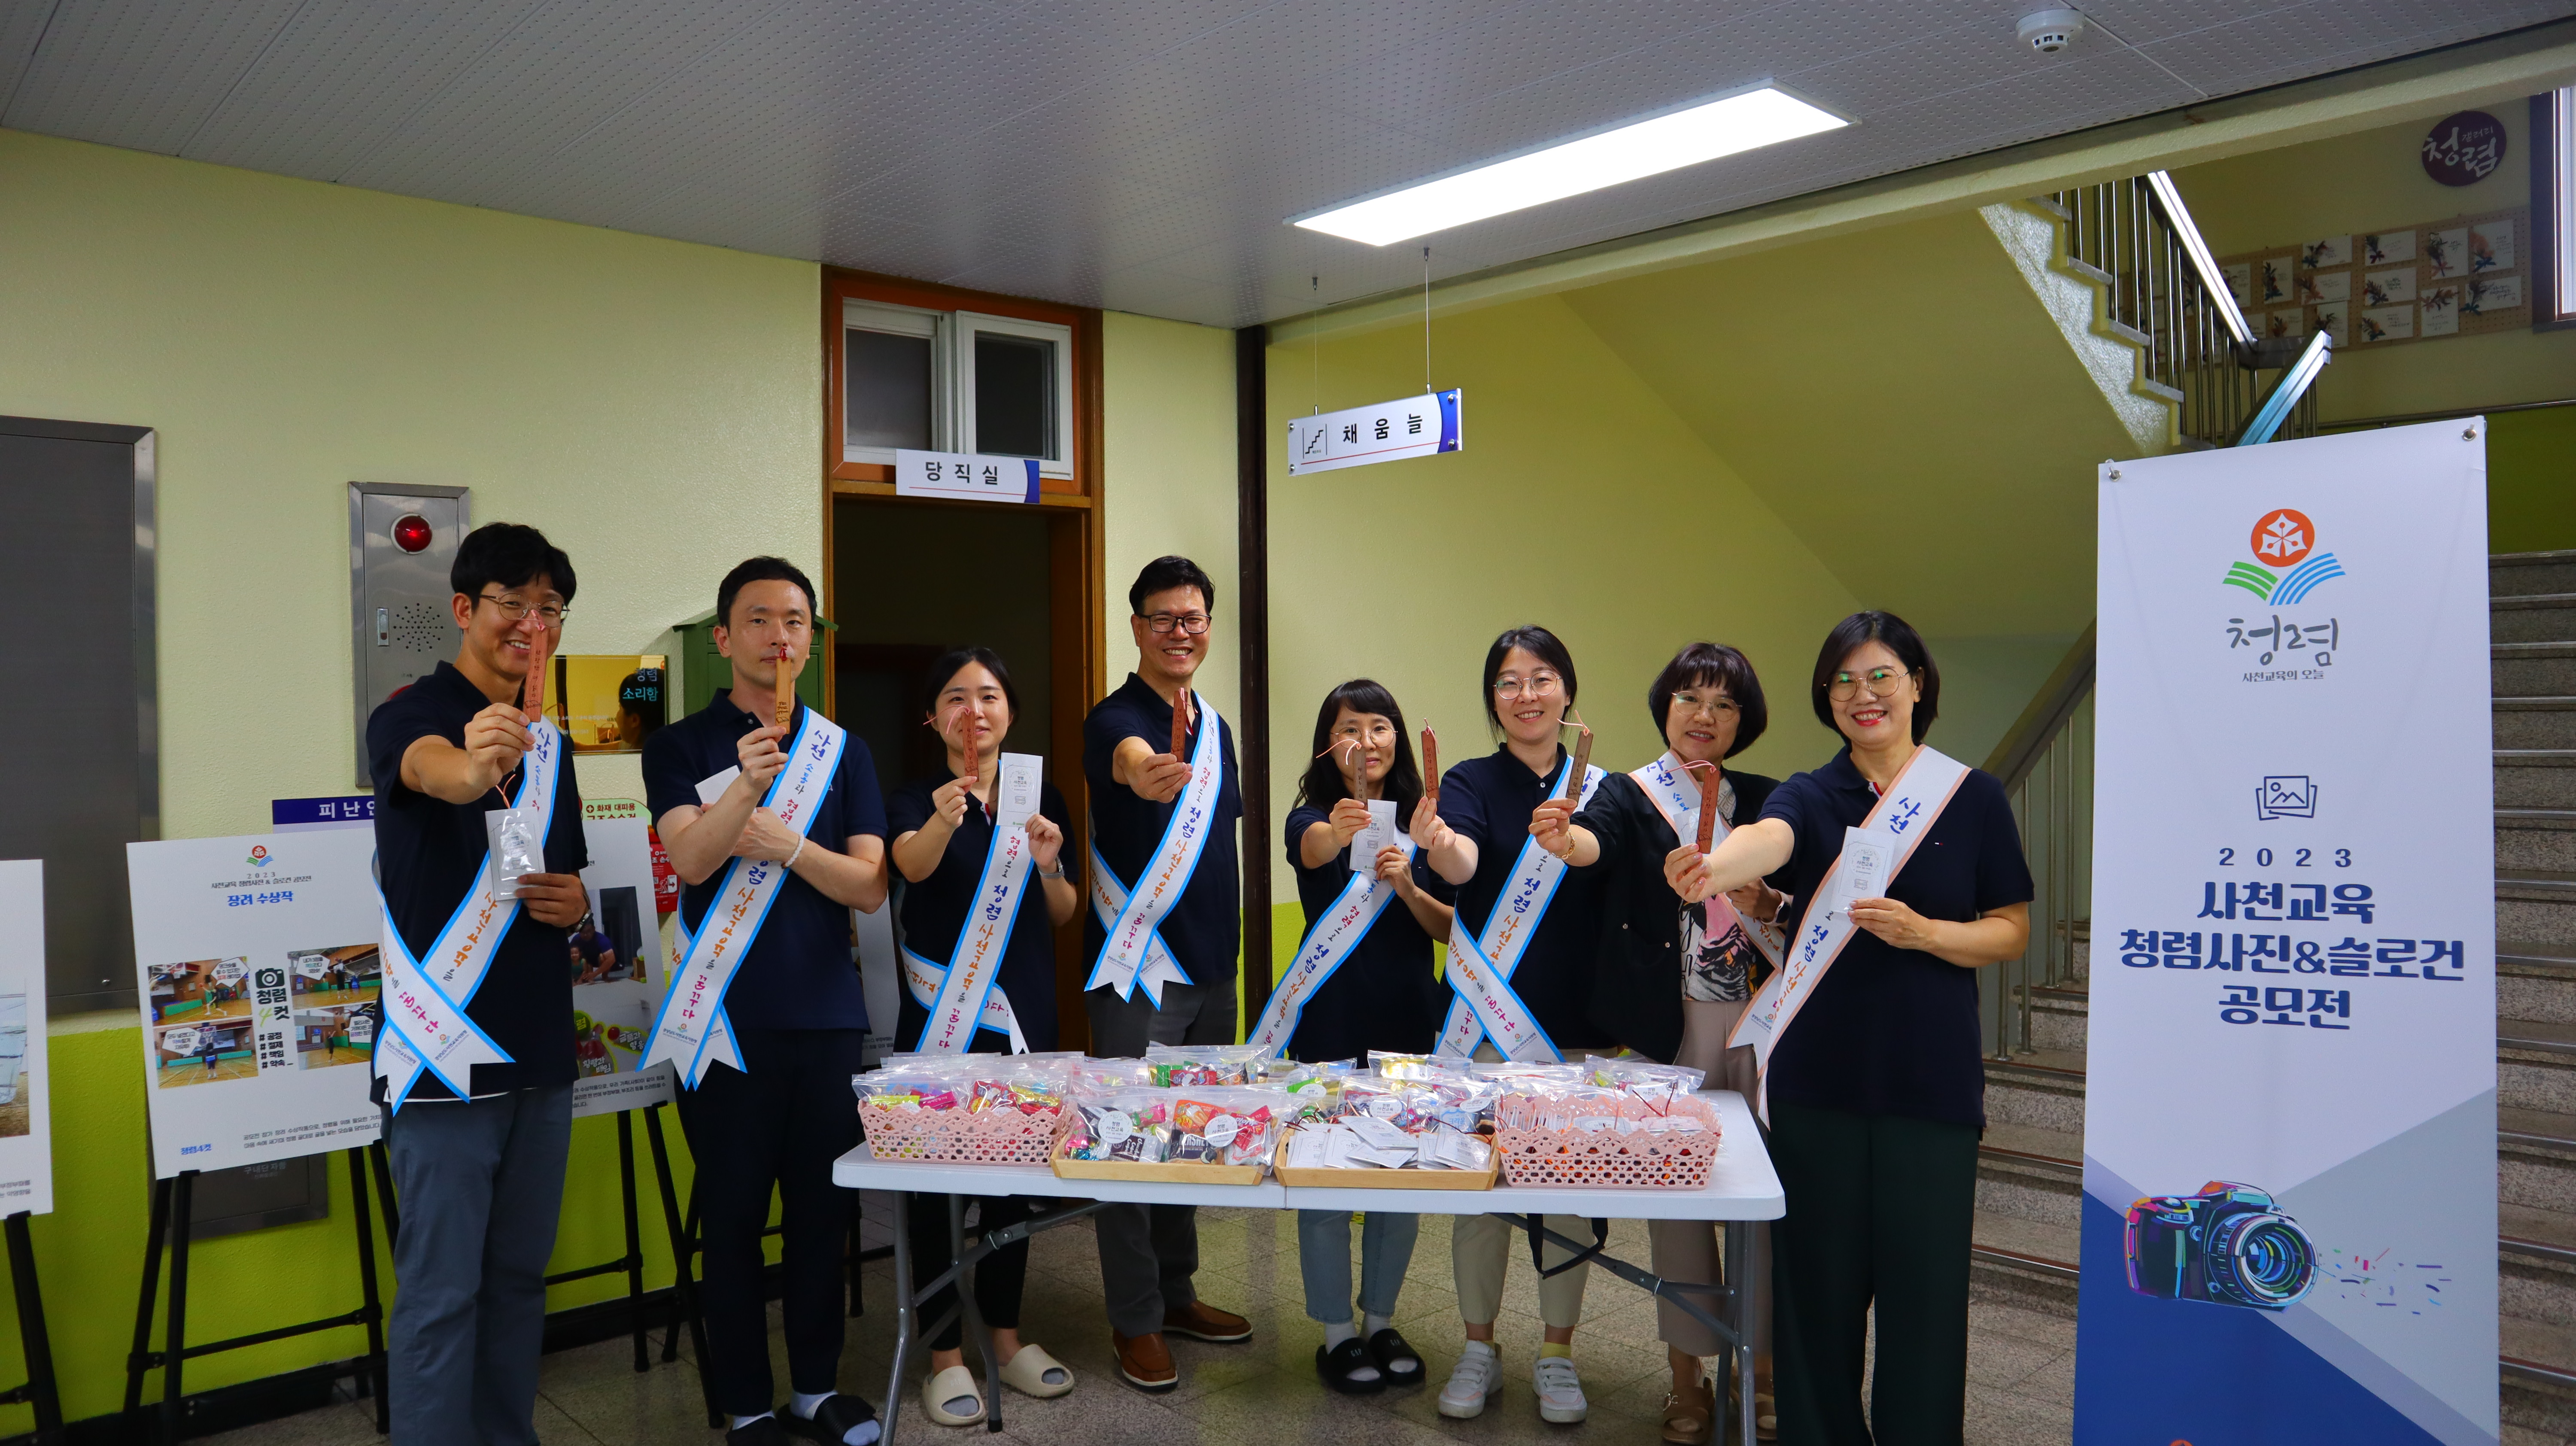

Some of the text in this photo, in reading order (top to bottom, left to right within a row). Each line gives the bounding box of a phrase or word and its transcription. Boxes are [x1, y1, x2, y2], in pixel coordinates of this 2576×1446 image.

[2422, 127, 2497, 177] 청렴
[2462, 126, 2494, 142] 갤러리
[2227, 615, 2339, 667] 청렴
[622, 687, 659, 701] 소리함
[2243, 669, 2324, 682] 사천교육의 오늘
[794, 730, 831, 795] 사천 소통과
[1646, 759, 1676, 787] 사천
[614, 803, 635, 811] 대피용
[1182, 806, 1201, 838] 청렴
[1889, 797, 1921, 834] 사천
[1002, 835, 1021, 878] 협력으로
[1145, 839, 1188, 910] 사천교육을
[2219, 848, 2351, 868] 2023
[228, 890, 294, 907] 장려 수상작
[239, 879, 264, 887] 청렴사진
[1513, 877, 1541, 913] 청렴
[986, 885, 1008, 920] 청렴
[2197, 881, 2376, 924] 사천교육
[682, 861, 769, 1019] 렴 사천교육을 꿈꾸다
[1122, 912, 1146, 950] 꿈꾸다
[1328, 905, 1361, 942] 협력으로
[1304, 943, 1330, 974] 청렴
[1805, 925, 1829, 963] 청렴
[2120, 929, 2464, 981] 청렴사진&슬로건
[958, 923, 994, 1003] 사천교육을
[257, 987, 287, 1005] 청렴
[398, 991, 439, 1034] 꿈꾸다
[1274, 971, 1307, 1029] 사천교육을
[1484, 995, 1516, 1032] 꿈꾸다
[2219, 985, 2350, 1030] 공모전
[939, 1008, 960, 1049] 꿈꾸다
[180, 1143, 212, 1155] 청렴4컷
